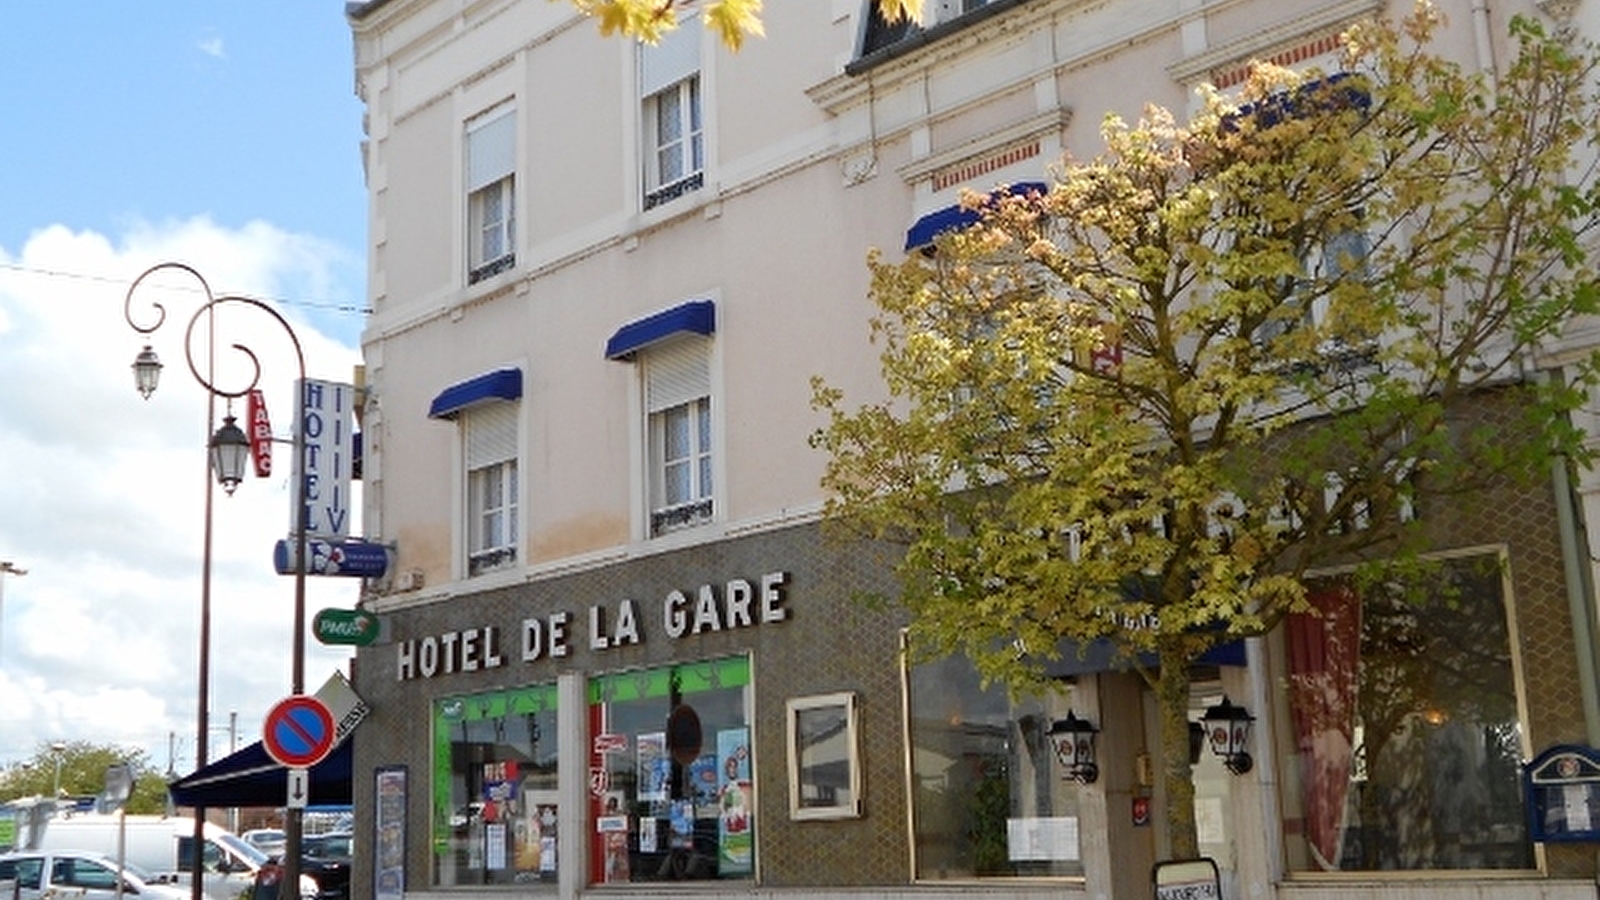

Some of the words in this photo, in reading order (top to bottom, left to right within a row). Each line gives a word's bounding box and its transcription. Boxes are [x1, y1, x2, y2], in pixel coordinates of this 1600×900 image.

[252, 391, 271, 472] TABAC
[305, 383, 323, 531] HOTEL
[397, 626, 502, 681] HOTEL
[522, 611, 568, 662] DE
[589, 599, 640, 650] LA
[664, 572, 787, 639] GARE
